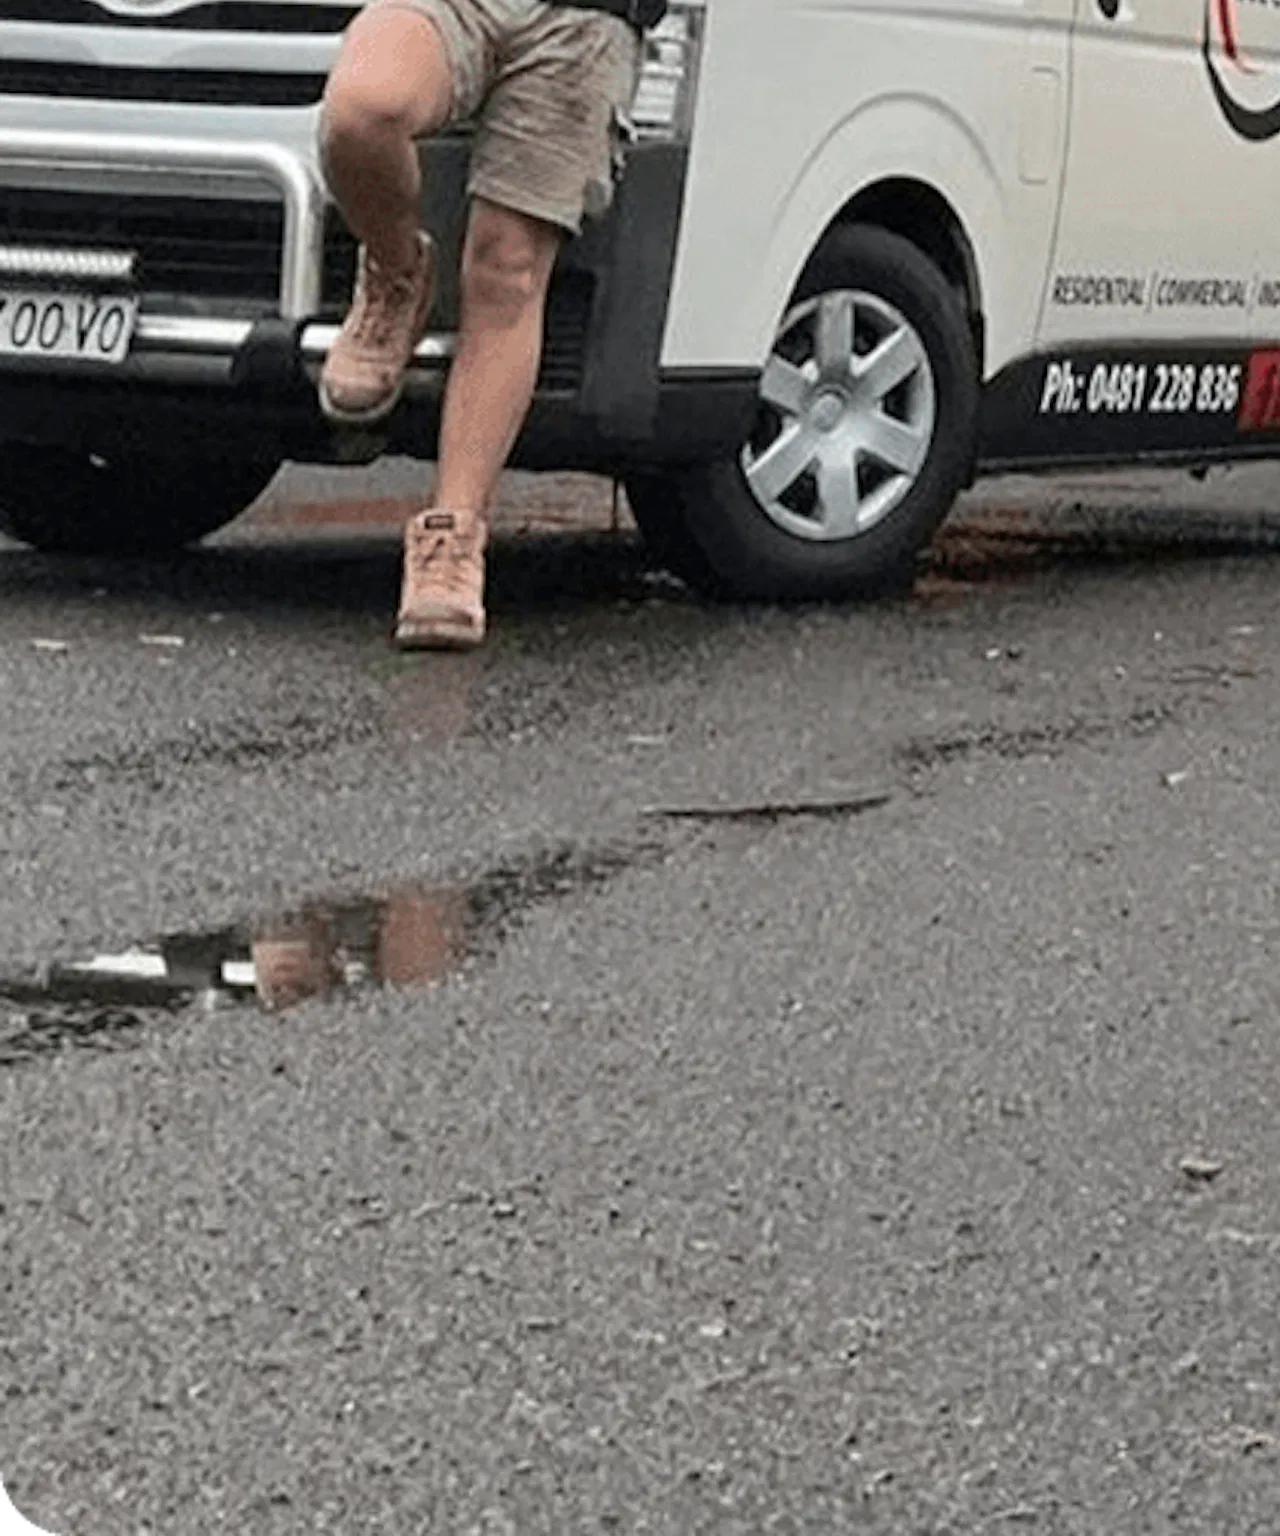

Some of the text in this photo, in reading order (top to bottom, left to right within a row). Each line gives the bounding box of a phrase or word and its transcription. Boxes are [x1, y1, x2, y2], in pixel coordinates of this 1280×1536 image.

[1040, 360, 1243, 413] Ph: 0481 228 836
